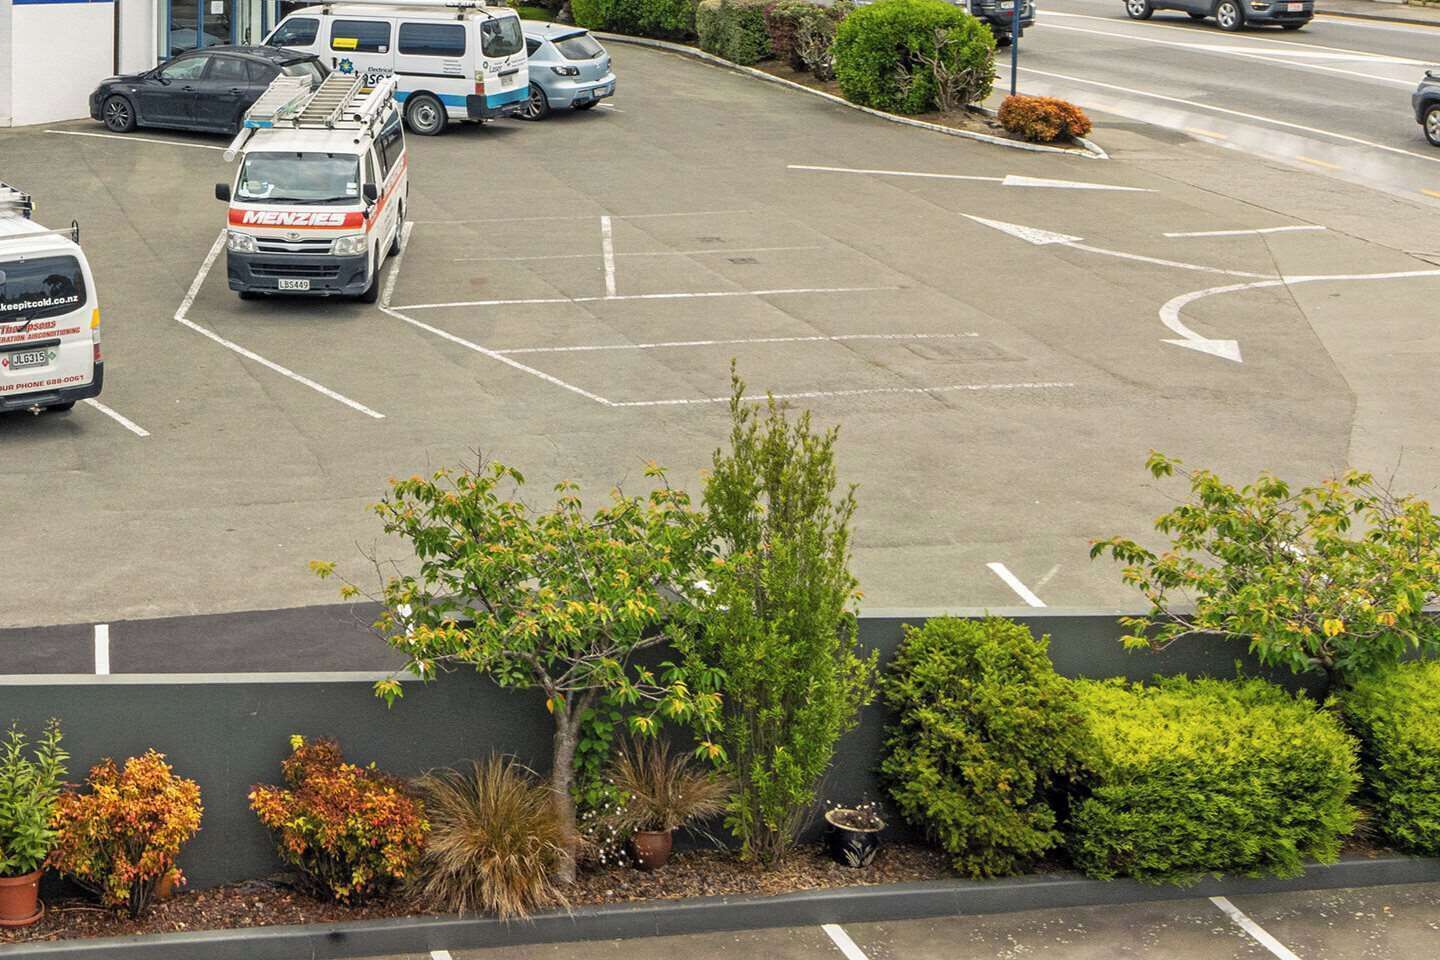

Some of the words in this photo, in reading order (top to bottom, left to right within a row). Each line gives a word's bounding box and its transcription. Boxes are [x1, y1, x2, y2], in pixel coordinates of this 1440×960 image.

[242, 210, 347, 227] MENZIES
[280, 280, 309, 289] LBS449
[27, 326, 81, 341] AIRCONDITIONING
[13, 352, 46, 366] JLG315
[15, 381, 45, 390] PHONE
